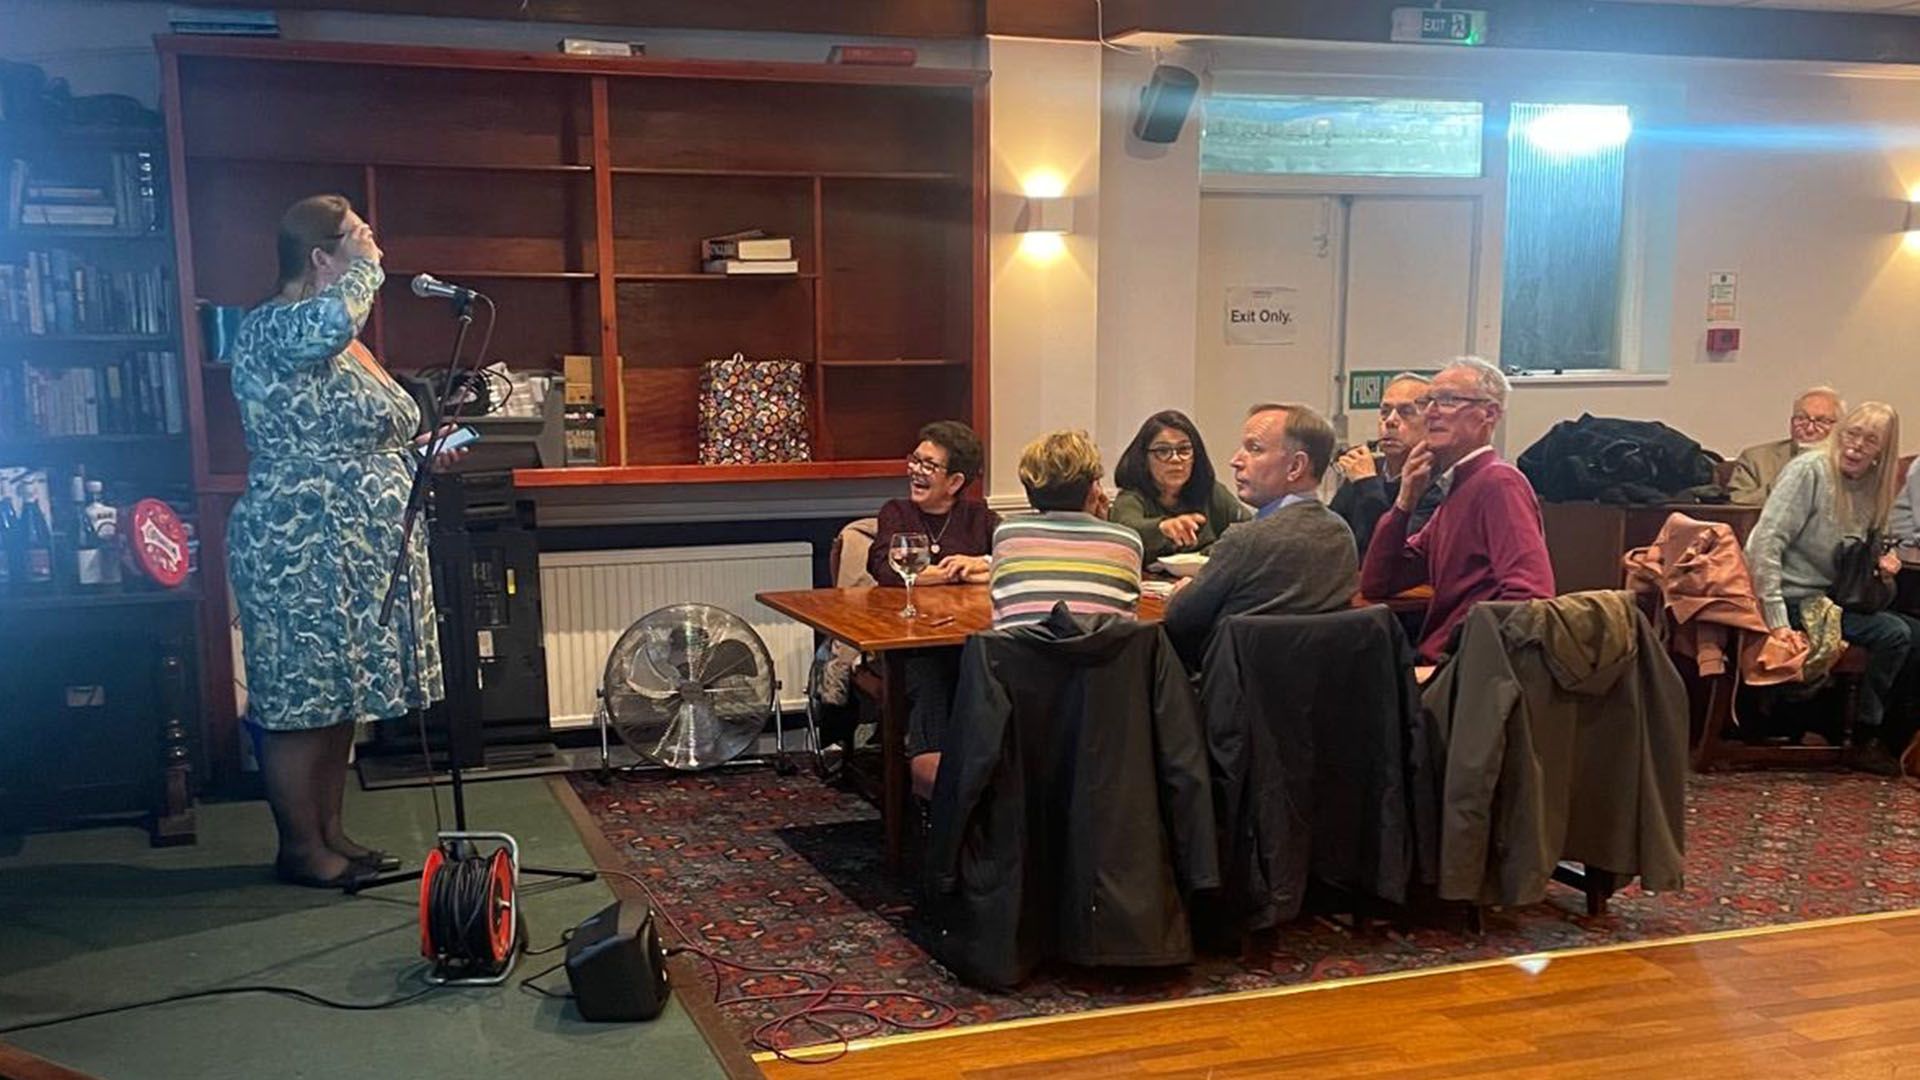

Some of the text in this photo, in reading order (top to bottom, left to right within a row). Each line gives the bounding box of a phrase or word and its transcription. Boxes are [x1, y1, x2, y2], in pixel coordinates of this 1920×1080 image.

[1231, 309, 1292, 325] Exit Only.
[1352, 376, 1381, 404] PUSH
